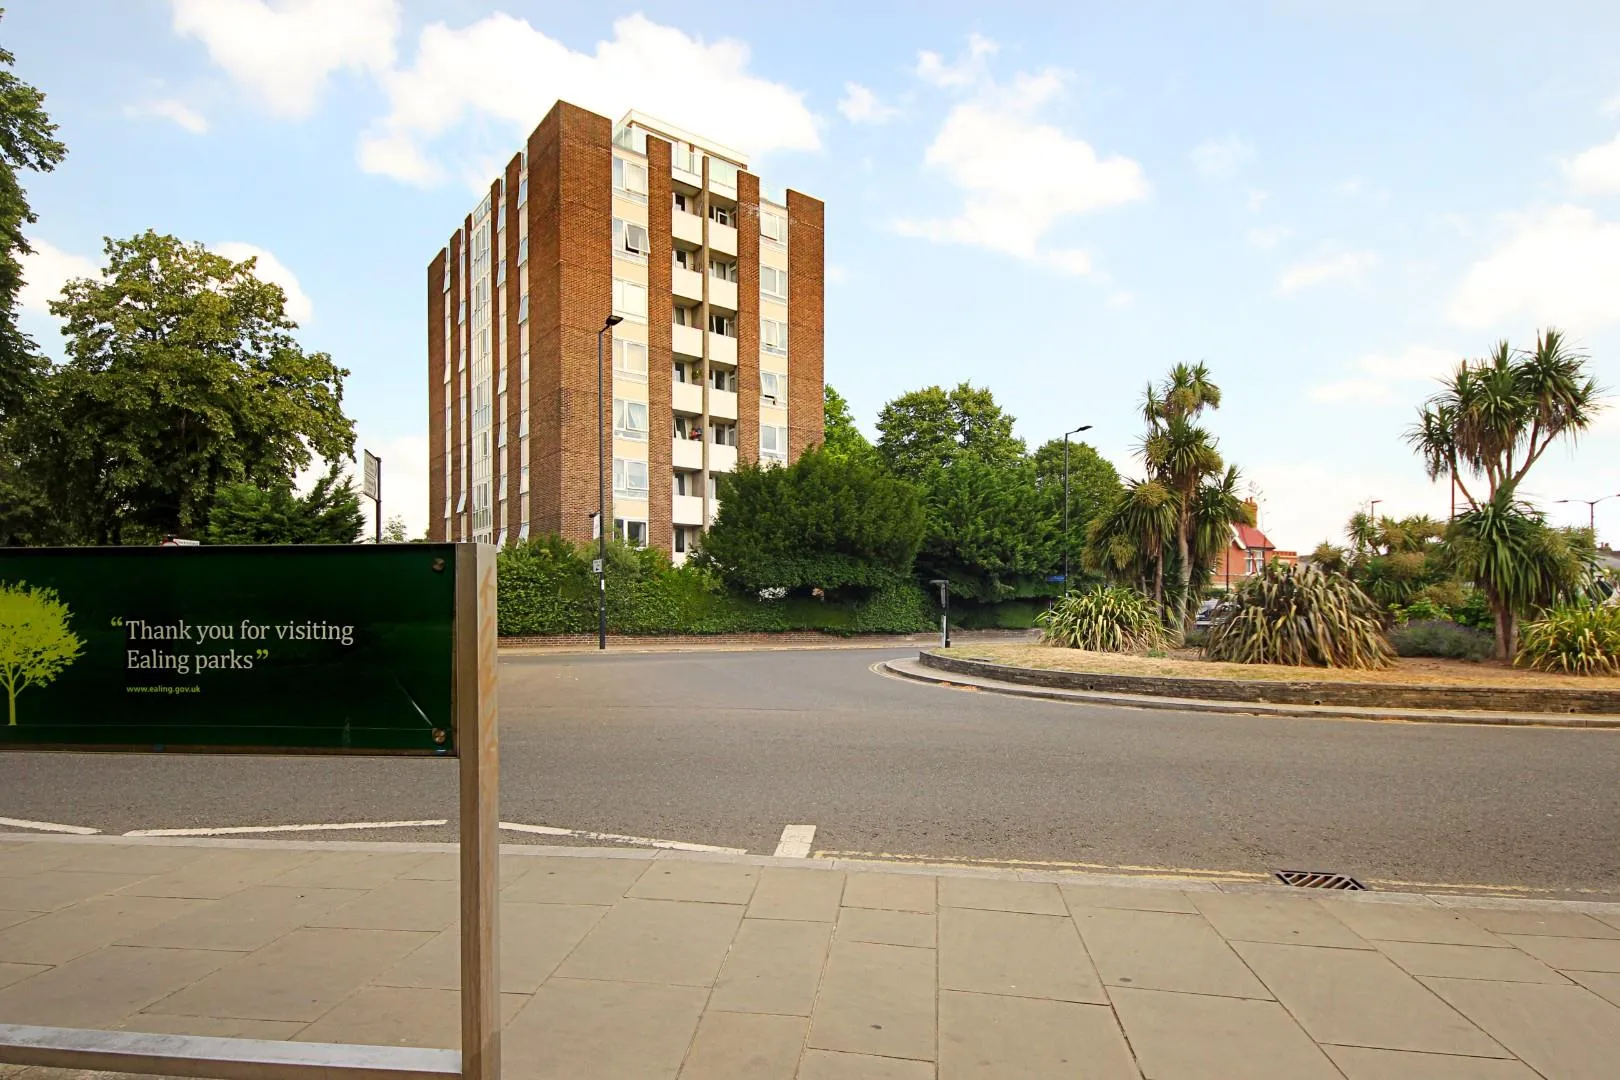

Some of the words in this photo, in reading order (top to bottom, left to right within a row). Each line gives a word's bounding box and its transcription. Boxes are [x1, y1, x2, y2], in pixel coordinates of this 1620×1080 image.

[196, 625, 234, 645] you
[240, 619, 270, 640] for
[275, 620, 354, 646] visiting
[127, 649, 190, 674] Ealing
[126, 684, 201, 694] www.ealing.gov.uk
